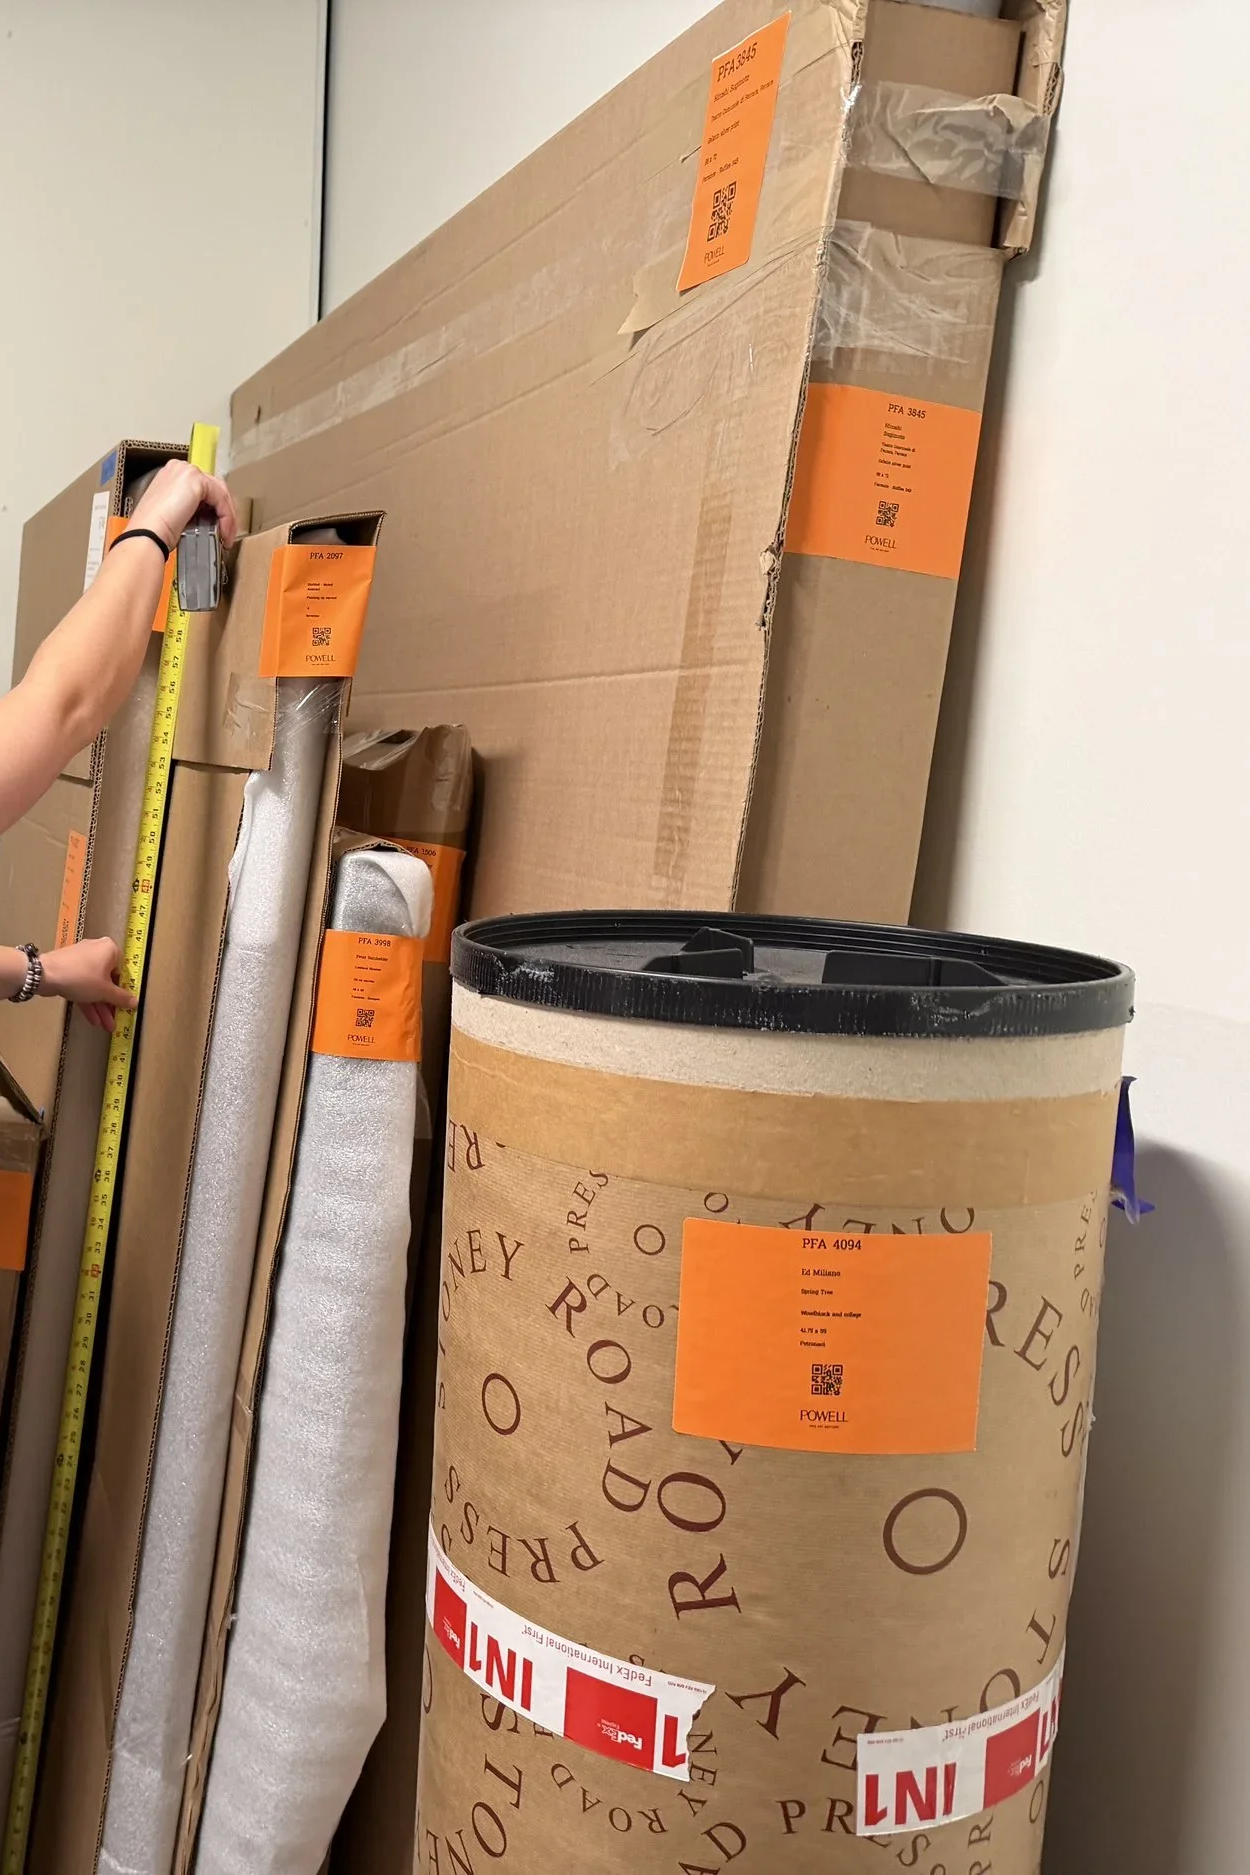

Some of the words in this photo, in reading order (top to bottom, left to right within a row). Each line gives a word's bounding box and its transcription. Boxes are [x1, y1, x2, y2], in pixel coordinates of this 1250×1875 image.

[717, 59, 735, 82] PFA
[736, 42, 757, 70] 3845
[888, 403, 904, 415] PFA
[907, 407, 927, 419] 3845
[864, 534, 897, 549] POWELL
[310, 552, 324, 560] PFA
[326, 552, 344, 560] 2097
[305, 654, 336, 662] POWELL
[358, 937, 372, 945] PFA
[374, 939, 392, 947] 3998
[347, 1034, 375, 1044] POWELL
[633, 1223, 667, 1256] O
[802, 1238, 827, 1250] PFA
[833, 1239, 862, 1251] 4094
[801, 1268, 811, 1276] Ed
[813, 1269, 841, 1277] Miliano
[801, 1288, 819, 1296] Spring
[801, 1310, 831, 1318] Woodblock
[481, 1372, 522, 1436] O
[800, 1409, 849, 1423] POWELL
[882, 1487, 969, 1575] O
[546, 1636, 614, 1674] International
[469, 1621, 534, 1713] IN1
[615, 1665, 653, 1687] FedEx
[601, 1724, 643, 1751] FedEx
[550, 1762, 668, 1834] ROAD
[864, 1761, 958, 1827] IN1
